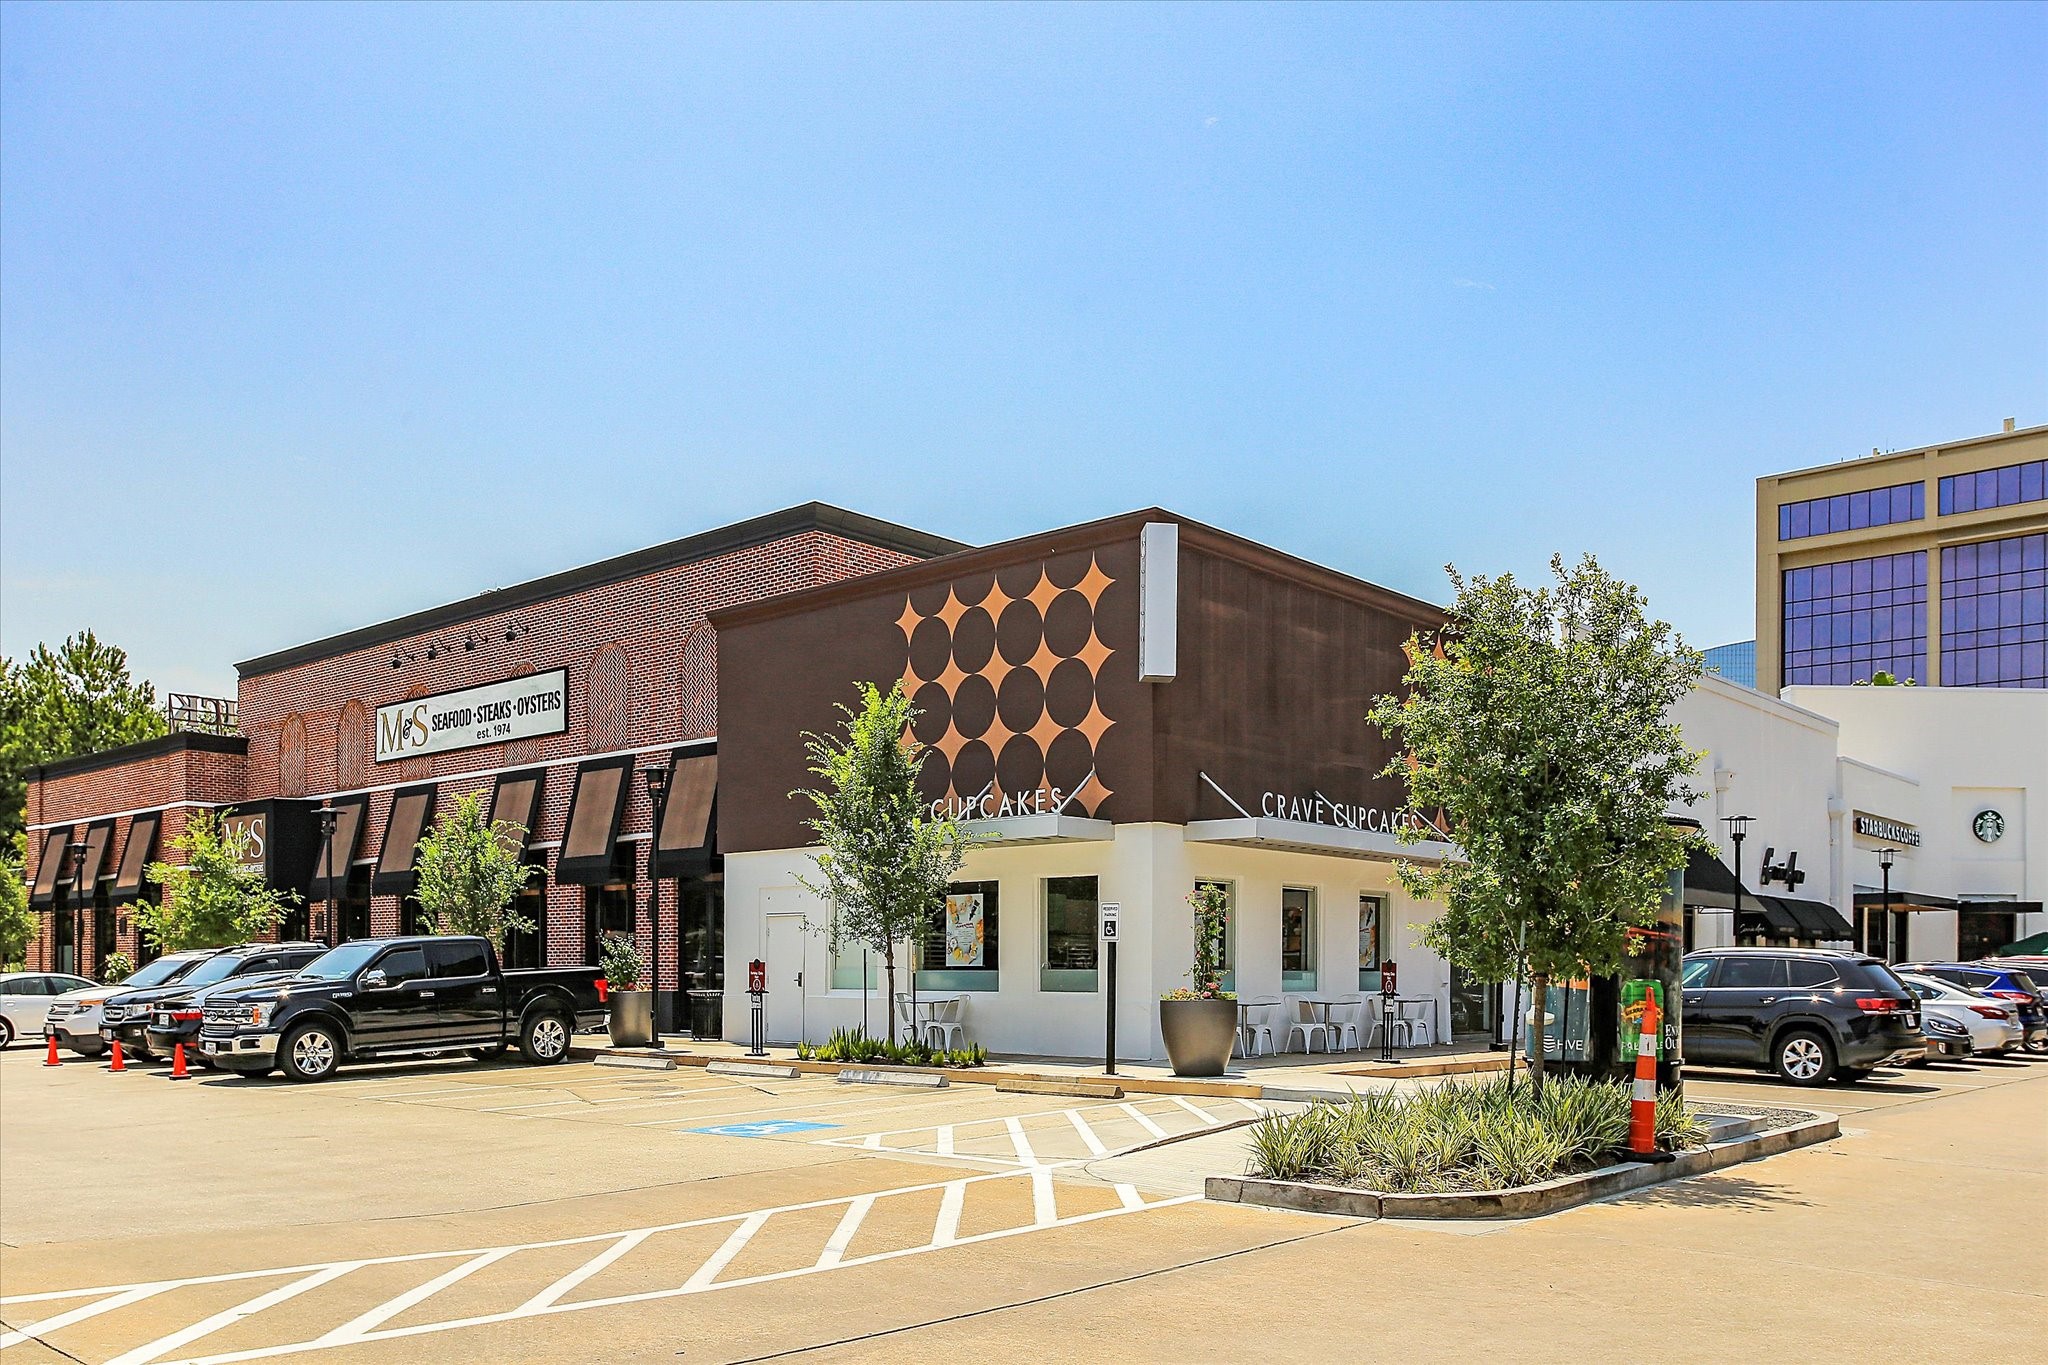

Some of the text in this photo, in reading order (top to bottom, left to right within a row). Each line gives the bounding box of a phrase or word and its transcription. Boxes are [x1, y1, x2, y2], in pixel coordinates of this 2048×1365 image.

[379, 704, 429, 754] M&S
[432, 690, 561, 732] SEAFOOD STEAKS OYSTERS
[477, 723, 511, 740] est. 1974
[931, 788, 1062, 822] CUPCAKES
[1262, 791, 1418, 834] CRAVE CUPCAKES
[1860, 817, 1920, 846] STARBUCKS COFFE
